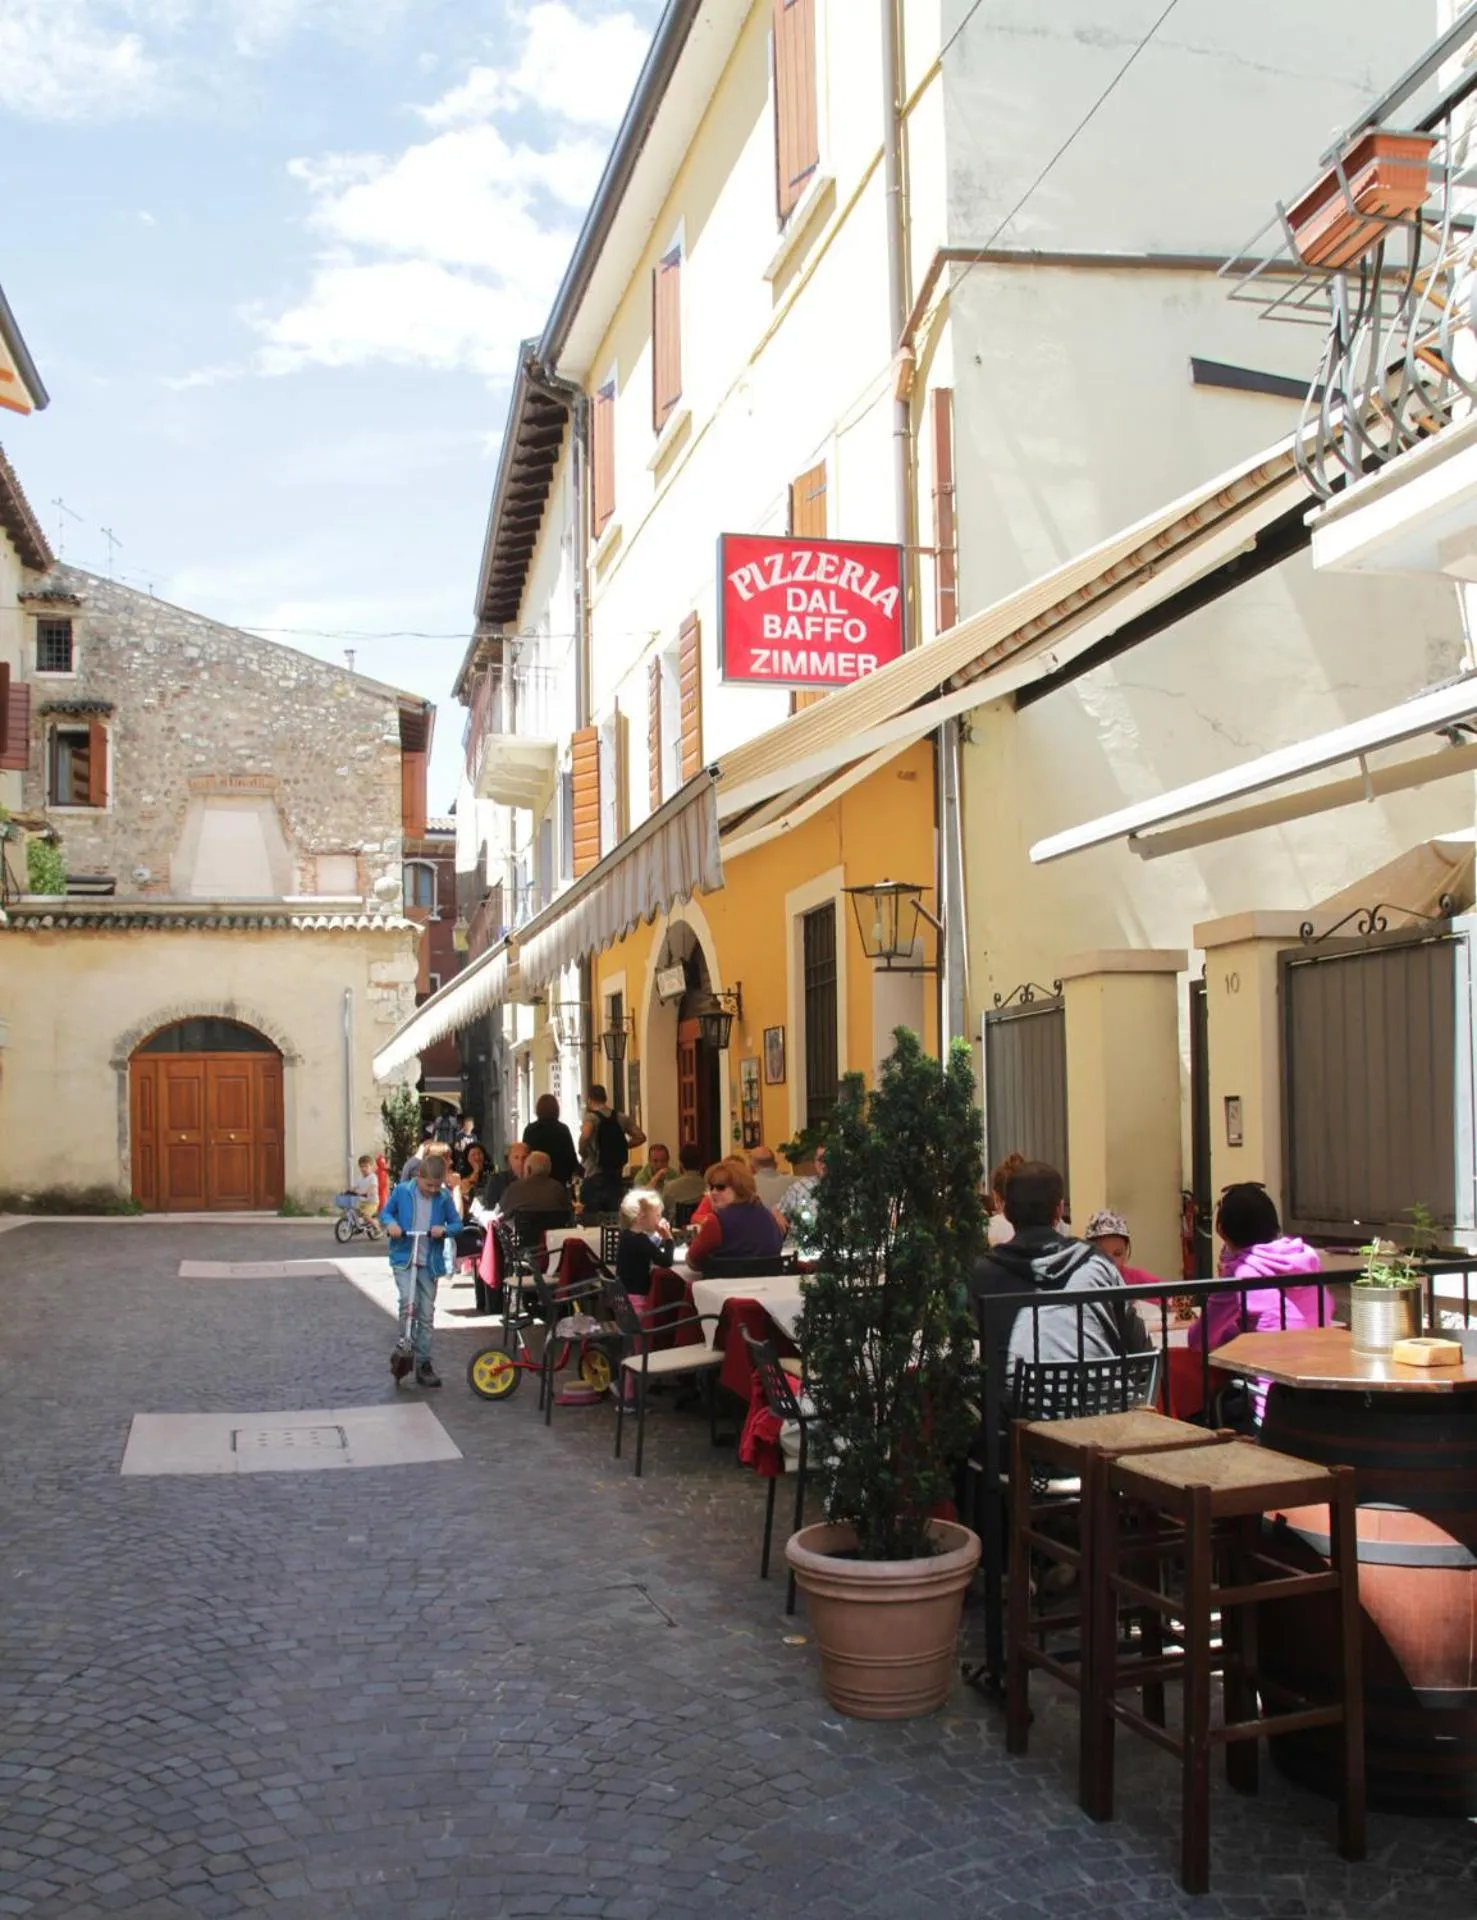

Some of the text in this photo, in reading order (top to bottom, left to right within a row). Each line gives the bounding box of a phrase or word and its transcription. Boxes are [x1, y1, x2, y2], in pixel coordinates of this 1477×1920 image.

[728, 551, 899, 619] PIZZERIA
[786, 588, 848, 615] DAL
[763, 614, 867, 643] BAFFO
[750, 649, 878, 677] ZIMMER
[1225, 971, 1240, 994] 10
